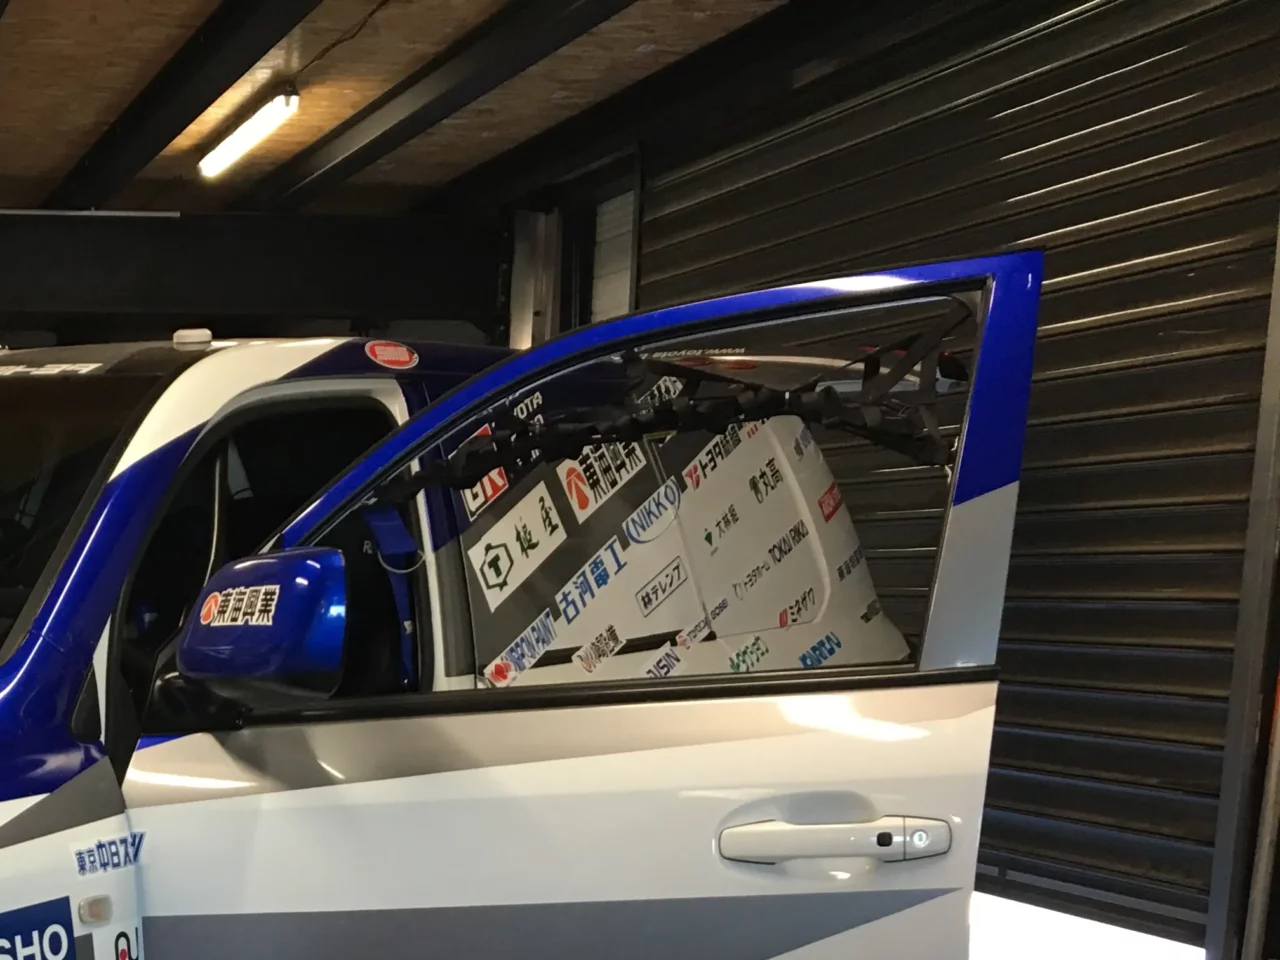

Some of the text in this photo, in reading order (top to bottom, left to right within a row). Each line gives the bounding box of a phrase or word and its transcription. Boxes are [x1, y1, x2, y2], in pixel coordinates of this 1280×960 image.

[630, 484, 678, 538] NIKKO
[558, 539, 628, 625] 古河電工
